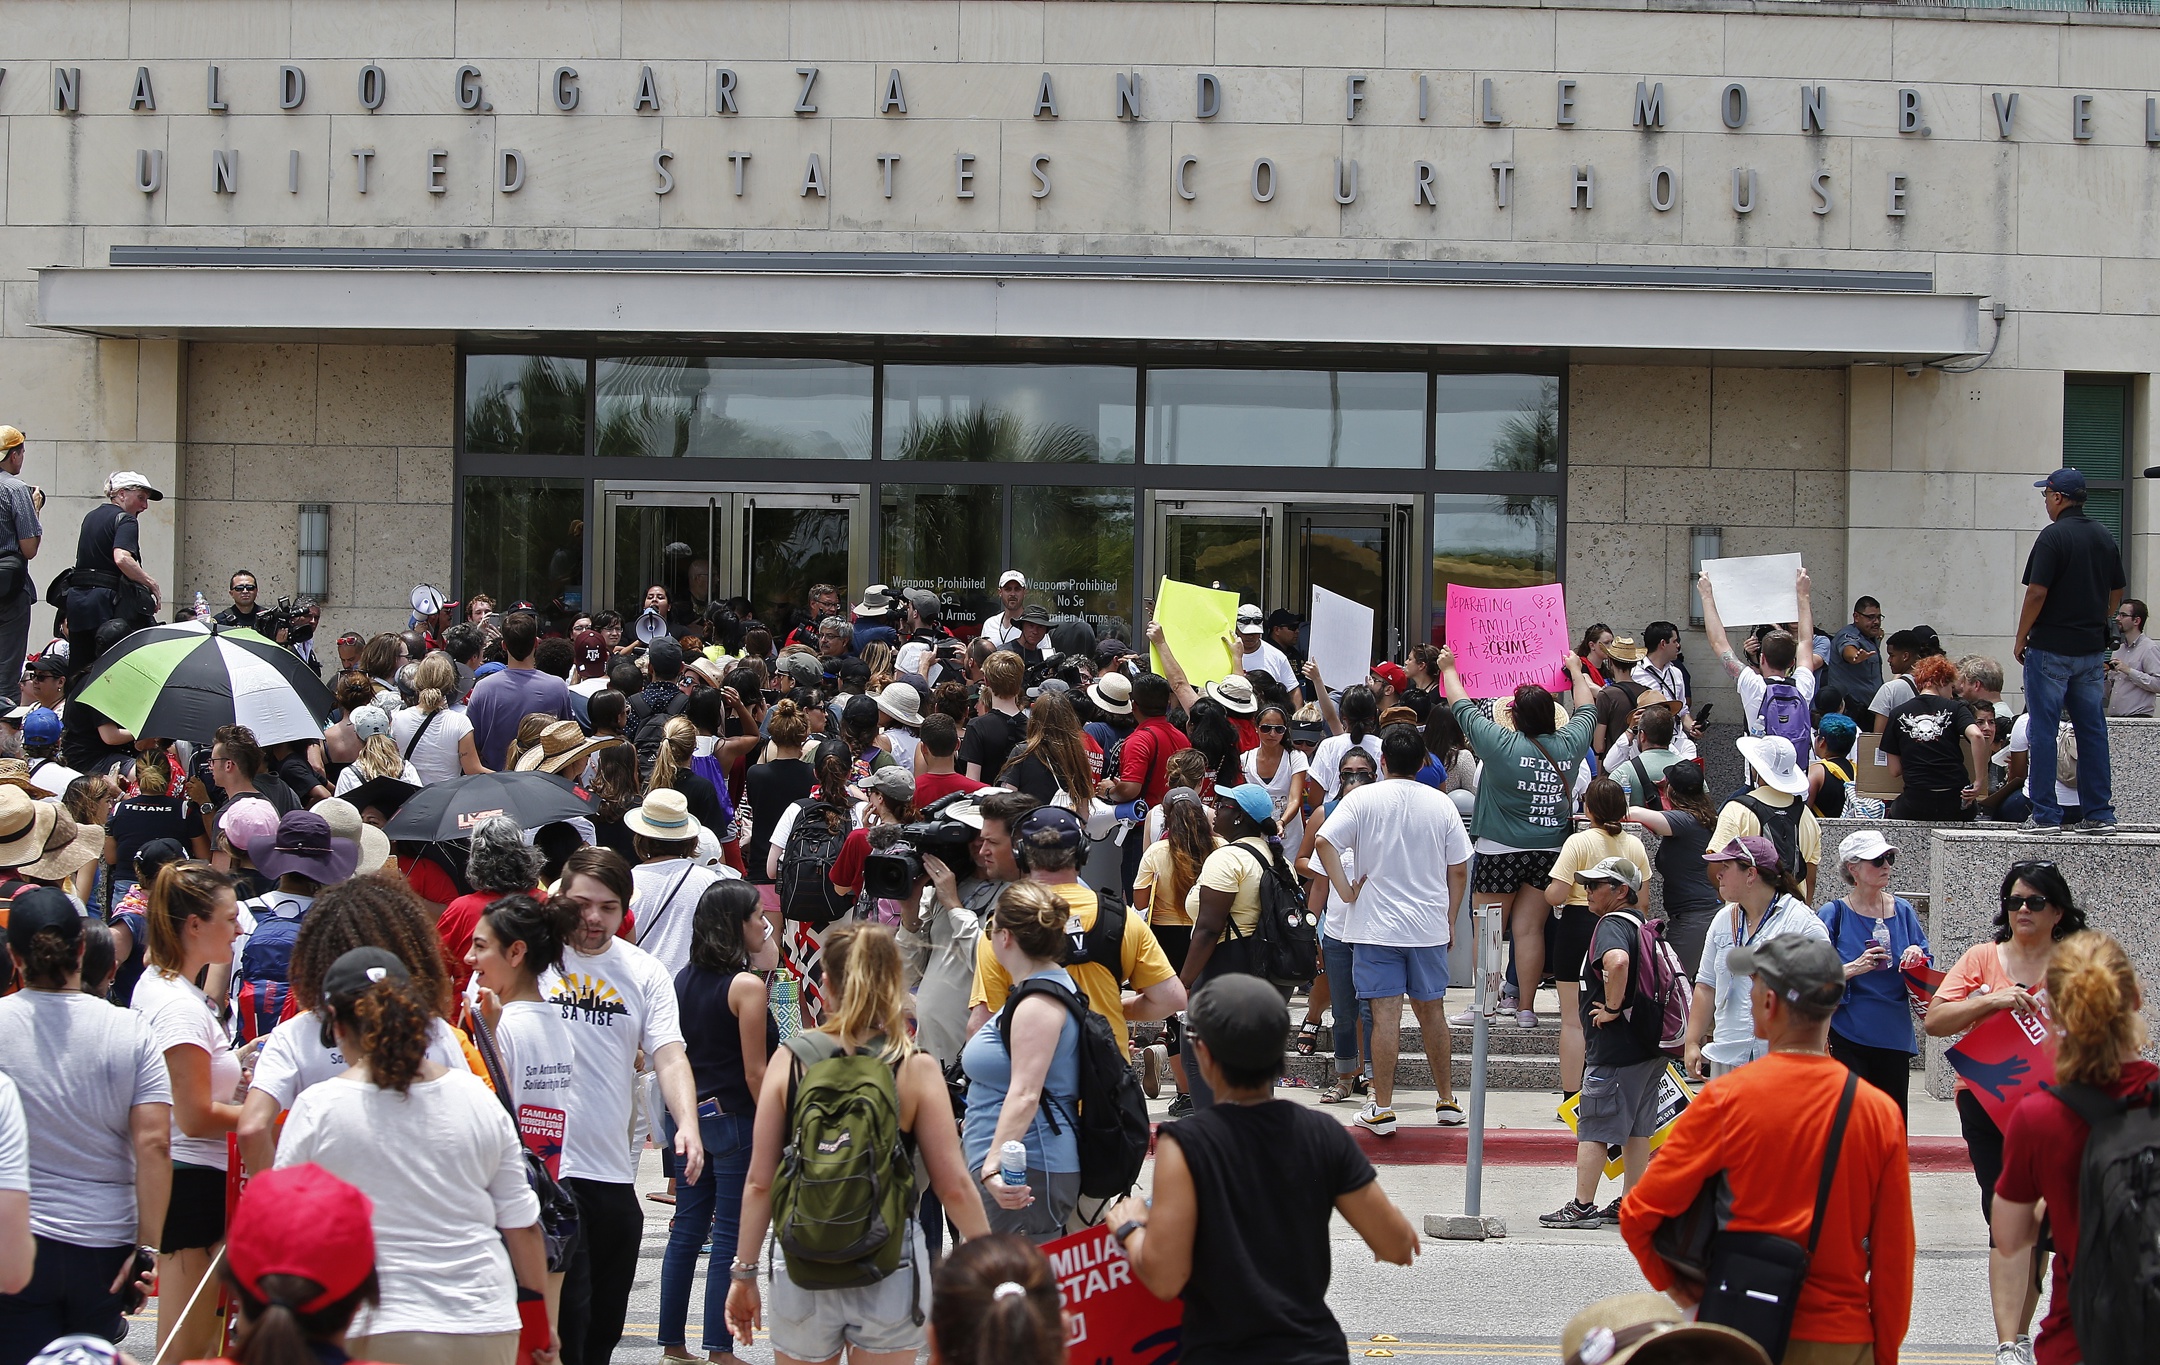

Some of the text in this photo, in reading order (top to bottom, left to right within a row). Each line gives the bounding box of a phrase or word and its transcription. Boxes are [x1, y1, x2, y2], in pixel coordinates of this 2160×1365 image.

[0, 65, 386, 113] NALDO
[553, 65, 907, 115] GARZA
[1033, 71, 1221, 121] AND
[1346, 74, 1827, 132] FILEMON
[136, 147, 1908, 218] UNITED STATES COURTHOUSE
[892, 575, 986, 590] Weapons Prohibited
[1069, 578, 1118, 591] Prohibited
[1057, 594, 1085, 607] No Se
[1450, 592, 1513, 617] SEPARATING
[946, 608, 976, 621] Armas
[1048, 611, 1076, 623] miten
[1471, 615, 1537, 635] FAMILIES
[1467, 641, 1479, 659] A
[1489, 639, 1534, 656] CRIME
[1456, 671, 1482, 689] INST
[1531, 793, 1563, 804] FREE
[124, 803, 172, 812] TEXANS
[1530, 805, 1555, 815] THE
[561, 1004, 613, 1027] SA RISE
[521, 1108, 564, 1122] FAMILIAS
[1049, 1231, 1129, 1279] MILIA
